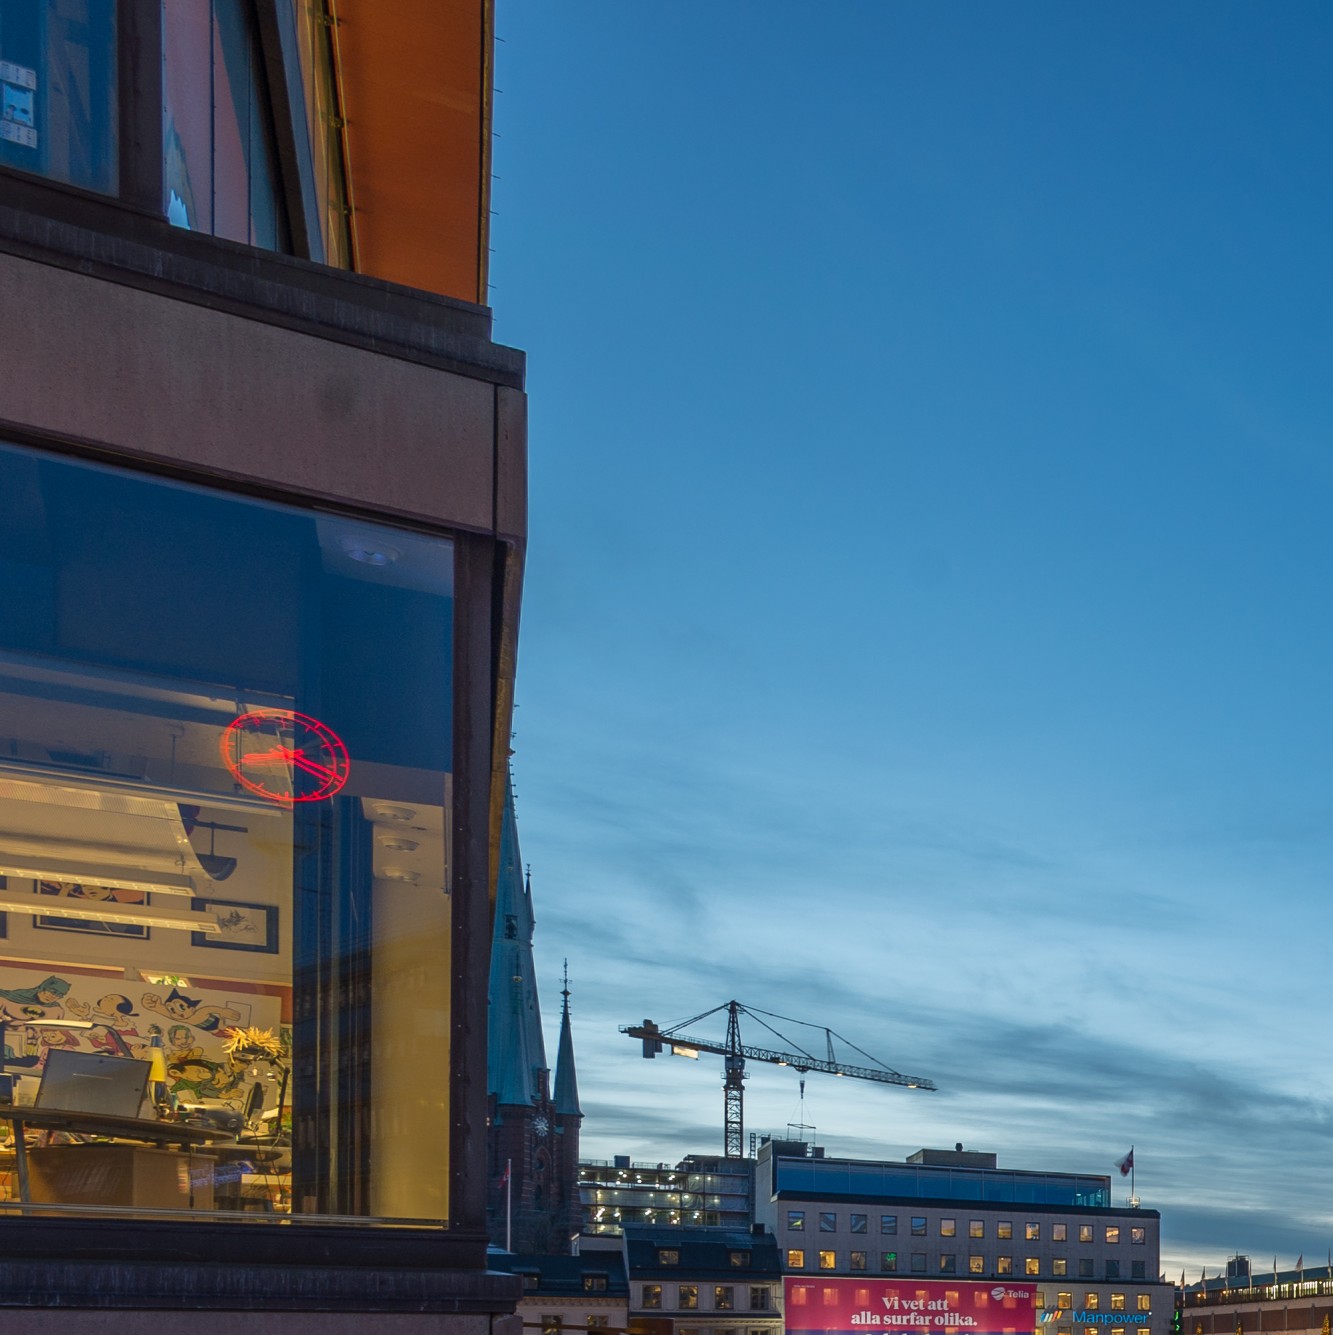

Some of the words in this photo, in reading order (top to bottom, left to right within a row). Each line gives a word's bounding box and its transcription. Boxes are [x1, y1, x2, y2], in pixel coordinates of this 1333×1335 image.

[1007, 1289, 1030, 1299] Telia
[882, 1297, 899, 1310] Vi
[902, 1298, 925, 1311] vet
[927, 1299, 950, 1311] att
[850, 1311, 881, 1325] alla
[883, 1312, 933, 1326] surfar
[934, 1313, 978, 1326] olika.
[1072, 1311, 1148, 1326] Manpower
